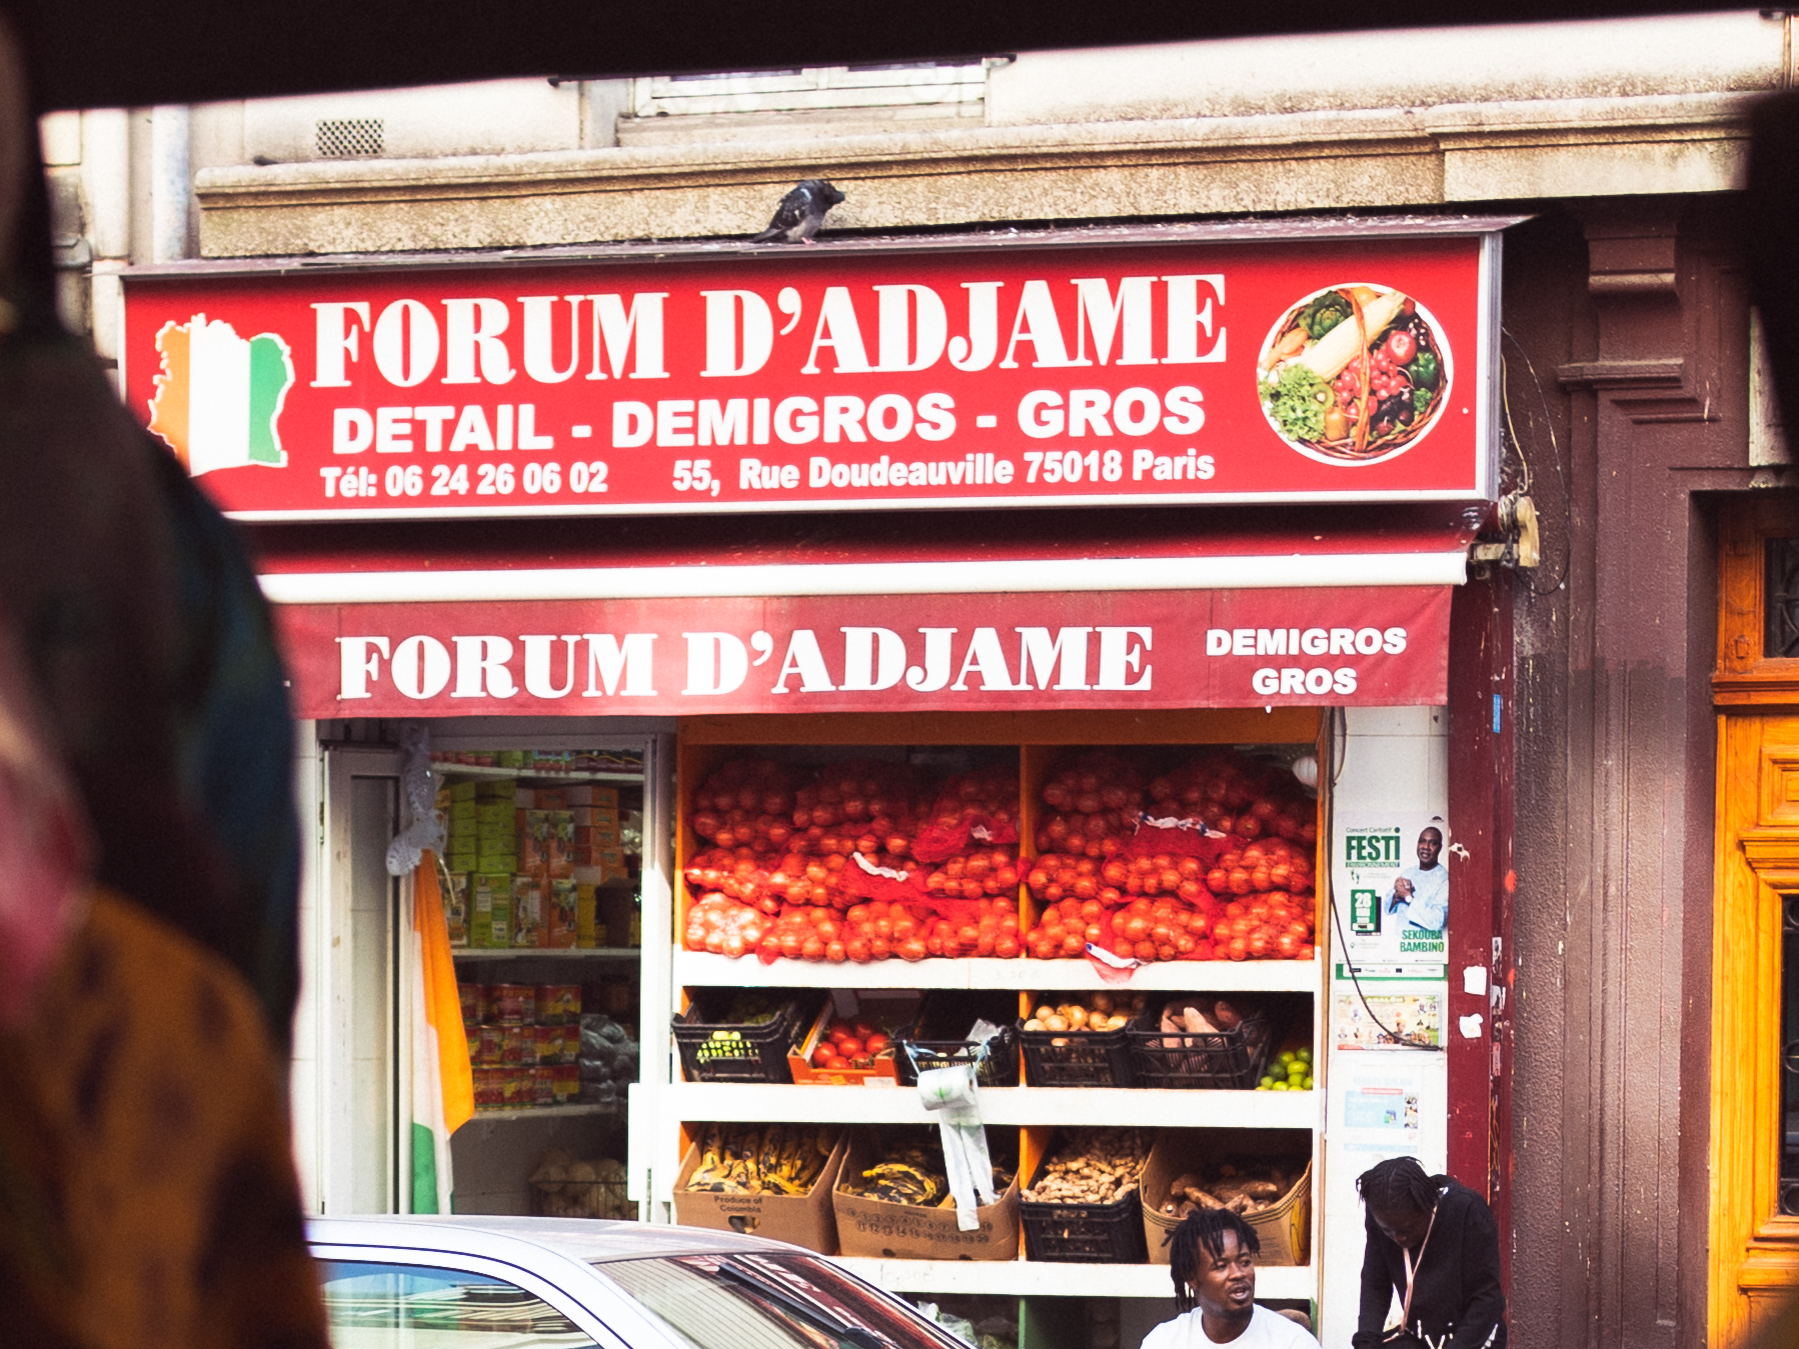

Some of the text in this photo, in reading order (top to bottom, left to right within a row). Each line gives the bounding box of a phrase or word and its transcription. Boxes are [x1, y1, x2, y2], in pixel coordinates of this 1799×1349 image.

[309, 292, 671, 388] FORUM
[332, 385, 1206, 455] DETAIL - DEMIGROS - GROS
[319, 447, 1216, 499] Tél: 06 24 26 06 02 55, Rue Doudeauville 75018 Paris
[1206, 627, 1407, 656] DEMIGROS
[334, 633, 659, 701] FORUM
[1252, 667, 1358, 696] GROS
[1345, 835, 1400, 861] FESTI
[1400, 941, 1445, 953] BAMBINO
[1401, 929, 1443, 940] SEKOUBA
[714, 1195, 751, 1204] Produce
[720, 1204, 762, 1213] Colombia
